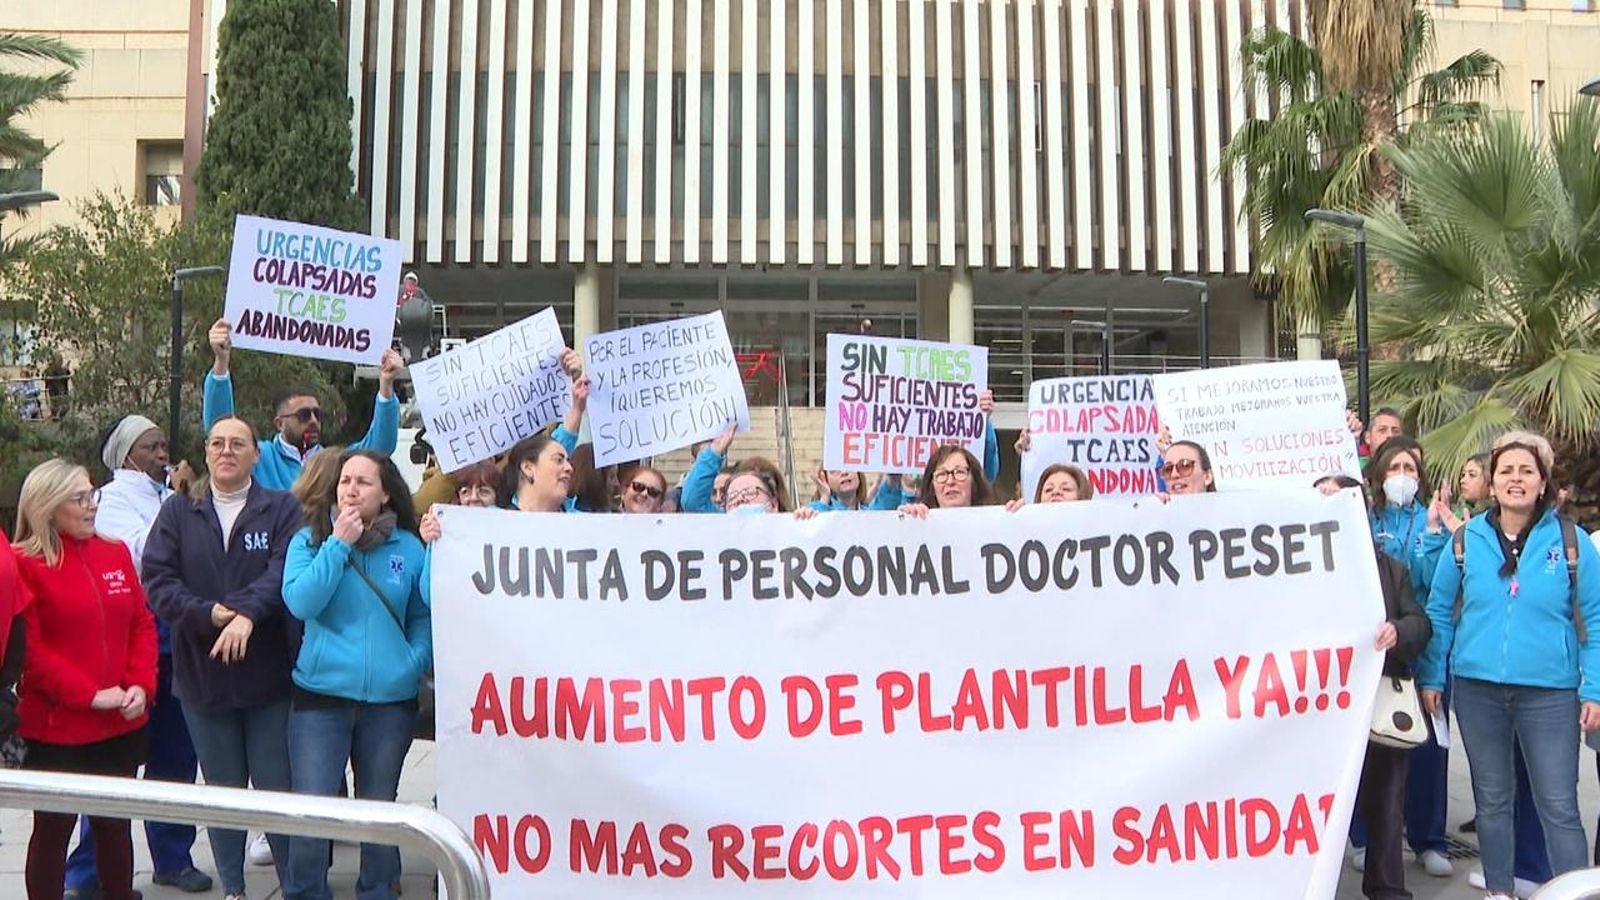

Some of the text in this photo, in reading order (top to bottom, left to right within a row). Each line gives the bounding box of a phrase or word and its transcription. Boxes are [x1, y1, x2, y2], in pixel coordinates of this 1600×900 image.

[256, 228, 382, 273] URGENCIAS
[253, 257, 377, 299] COLAPSADAS
[273, 287, 347, 323] TCAES
[235, 308, 371, 352] ABANDONADAS
[426, 317, 552, 383] SIN TCAES
[589, 321, 716, 364] POR EL PACIENTE
[435, 347, 559, 407] SUFICIENTES
[597, 345, 732, 391] Y LA PROFESIÓN,
[840, 342, 972, 382] SIN TCAES
[840, 372, 978, 410] SUFICIENTES
[1041, 377, 1154, 404] URGENCIA
[1167, 386, 1187, 404] SI
[433, 411, 457, 434] NO
[460, 399, 490, 426] HAY
[600, 395, 738, 456] SOLUCIÓN!
[838, 402, 984, 439] NO HAY TRABAJO
[1029, 405, 1160, 434] COLAPSADA
[1176, 404, 1225, 421] TRABAJO
[1067, 438, 1150, 463] TCAES
[1242, 429, 1344, 454] SOLUCIONES
[471, 519, 1341, 602] JUNTA DE PERSONAL DOCTOR PESET
[471, 646, 1354, 744] AUMENTO DE PLANTILLA YA!!!
[473, 812, 552, 876] NO
[569, 817, 693, 879] MAS
[706, 810, 1006, 882] RECORTES
[1019, 809, 1095, 873] EN
